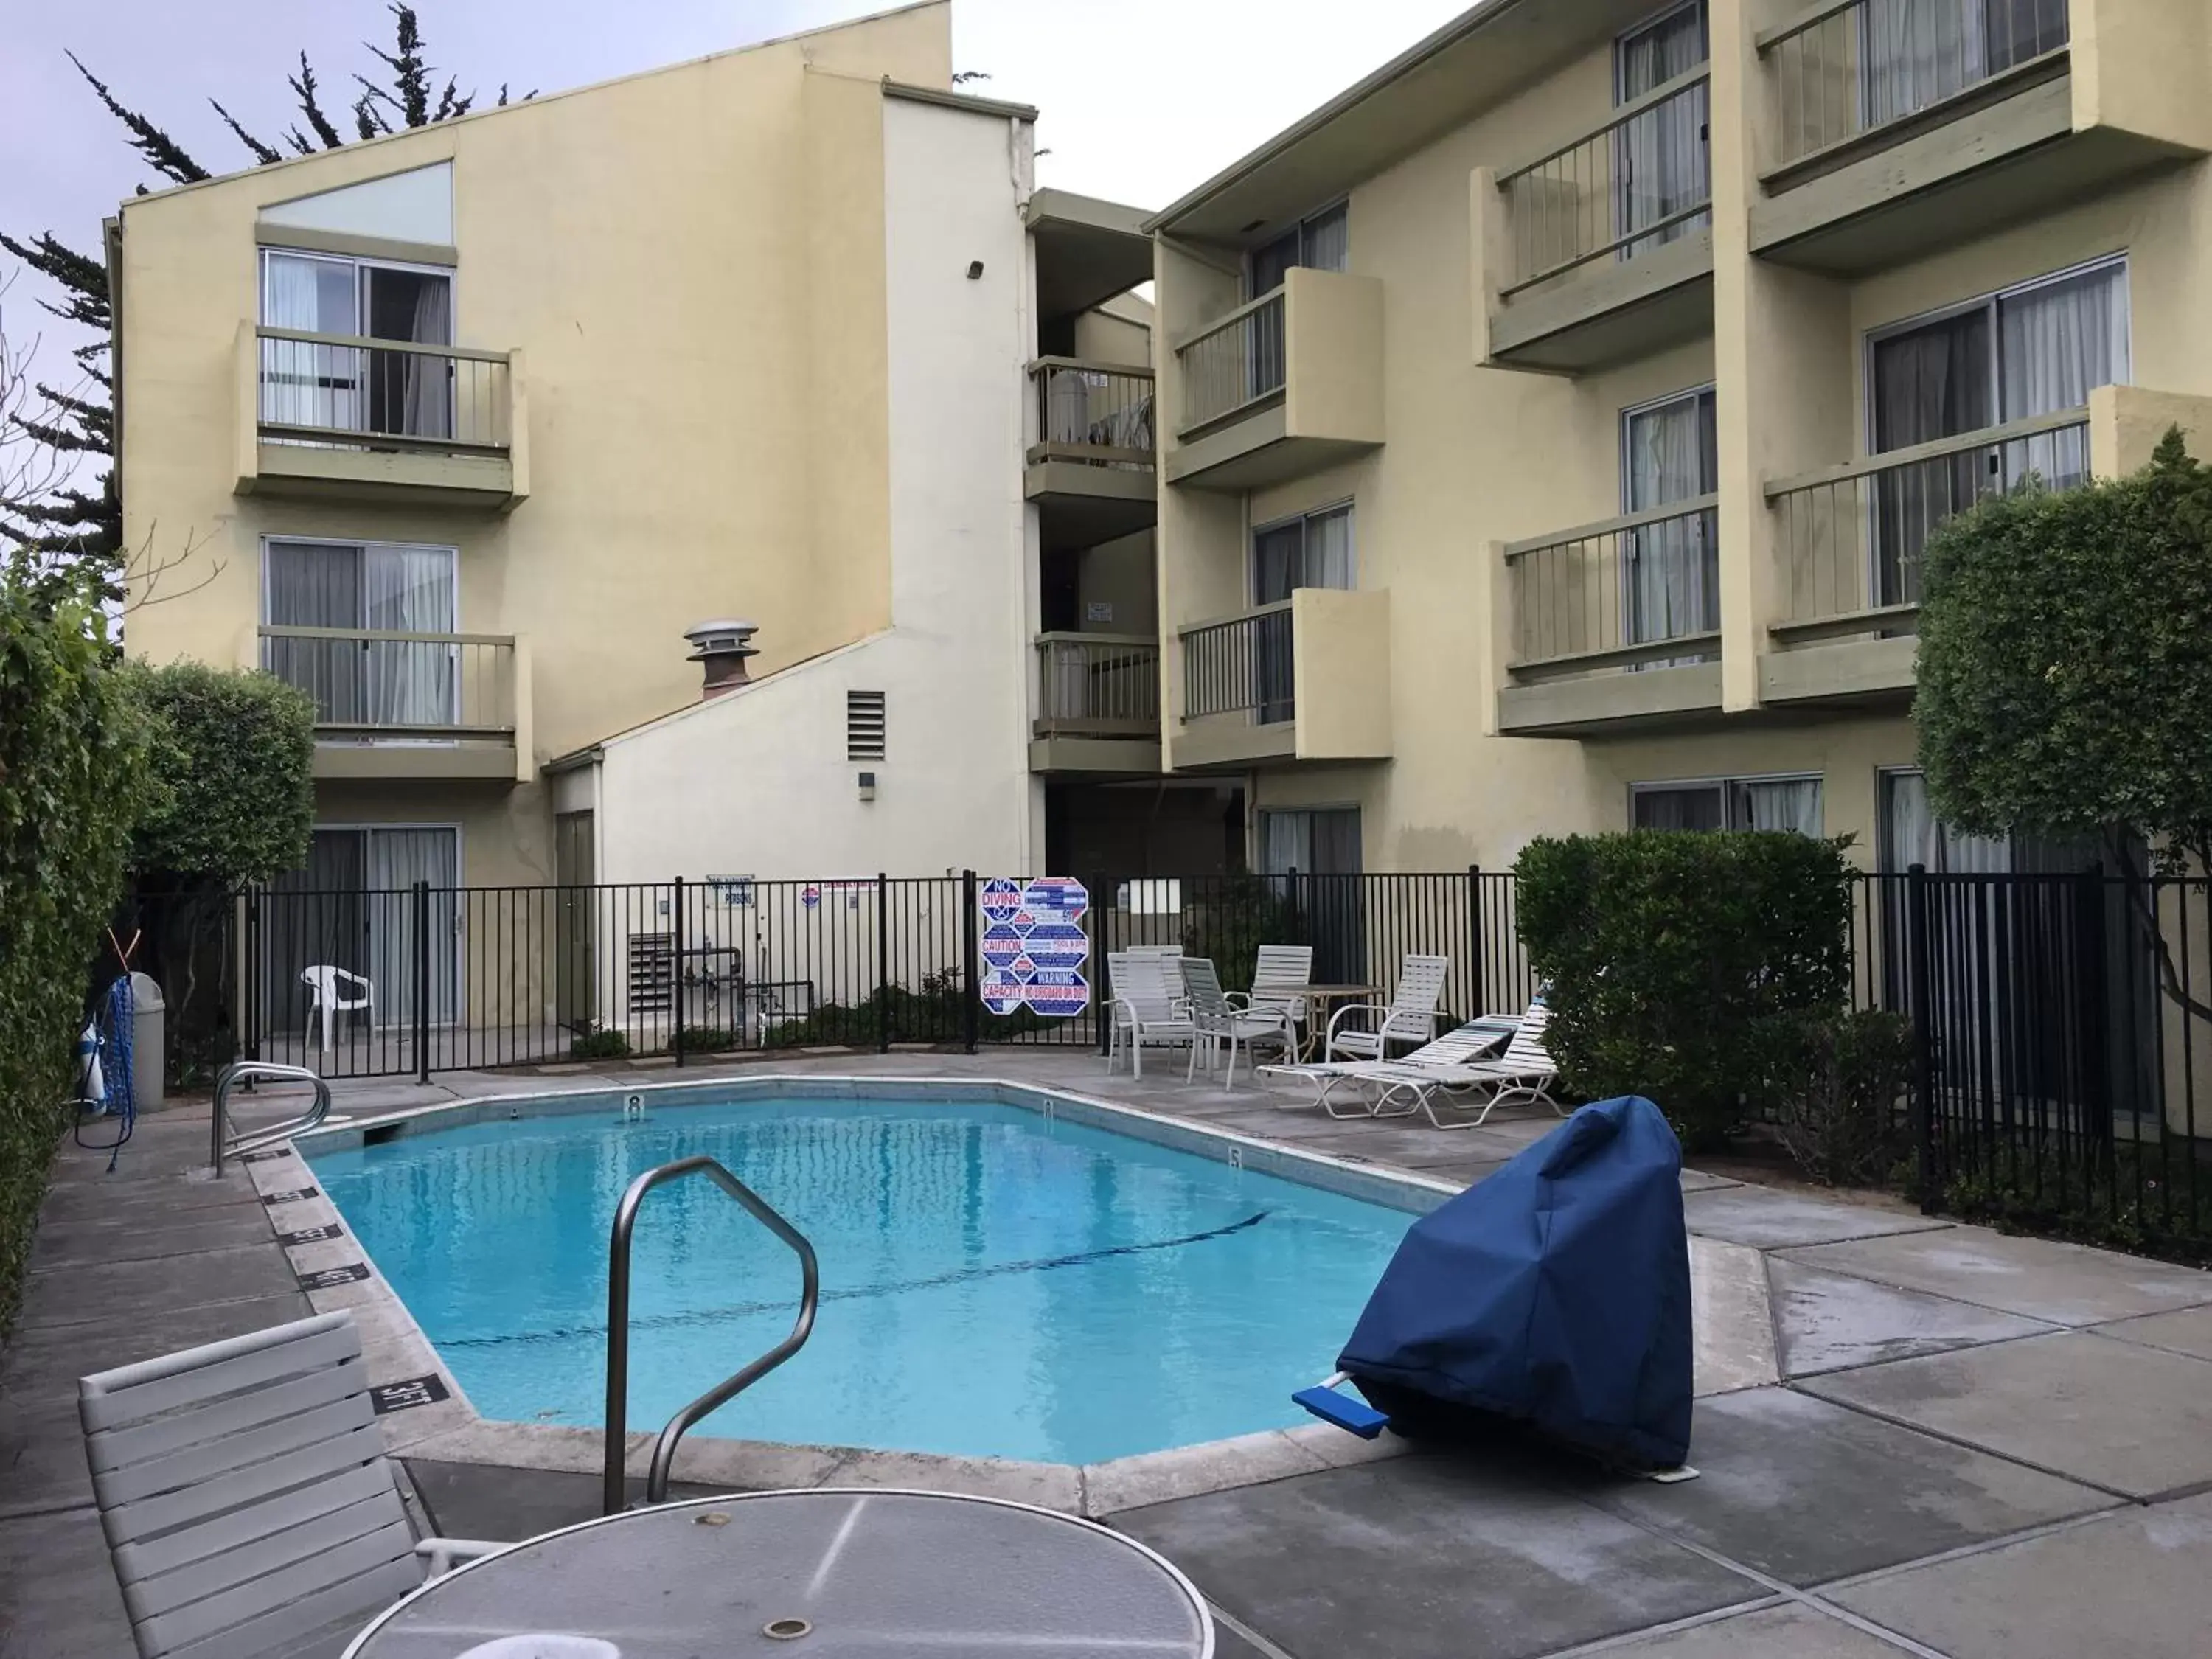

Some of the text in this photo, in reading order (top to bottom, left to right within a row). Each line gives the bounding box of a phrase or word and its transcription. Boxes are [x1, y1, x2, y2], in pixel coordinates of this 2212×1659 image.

[995, 880, 1010, 892] NO
[982, 893, 1021, 905] DIVING
[982, 940, 1021, 951] CAUTION
[1037, 972, 1074, 984] WARNING
[984, 986, 1021, 997] CAPACITY
[381, 1382, 432, 1409] 3FT
